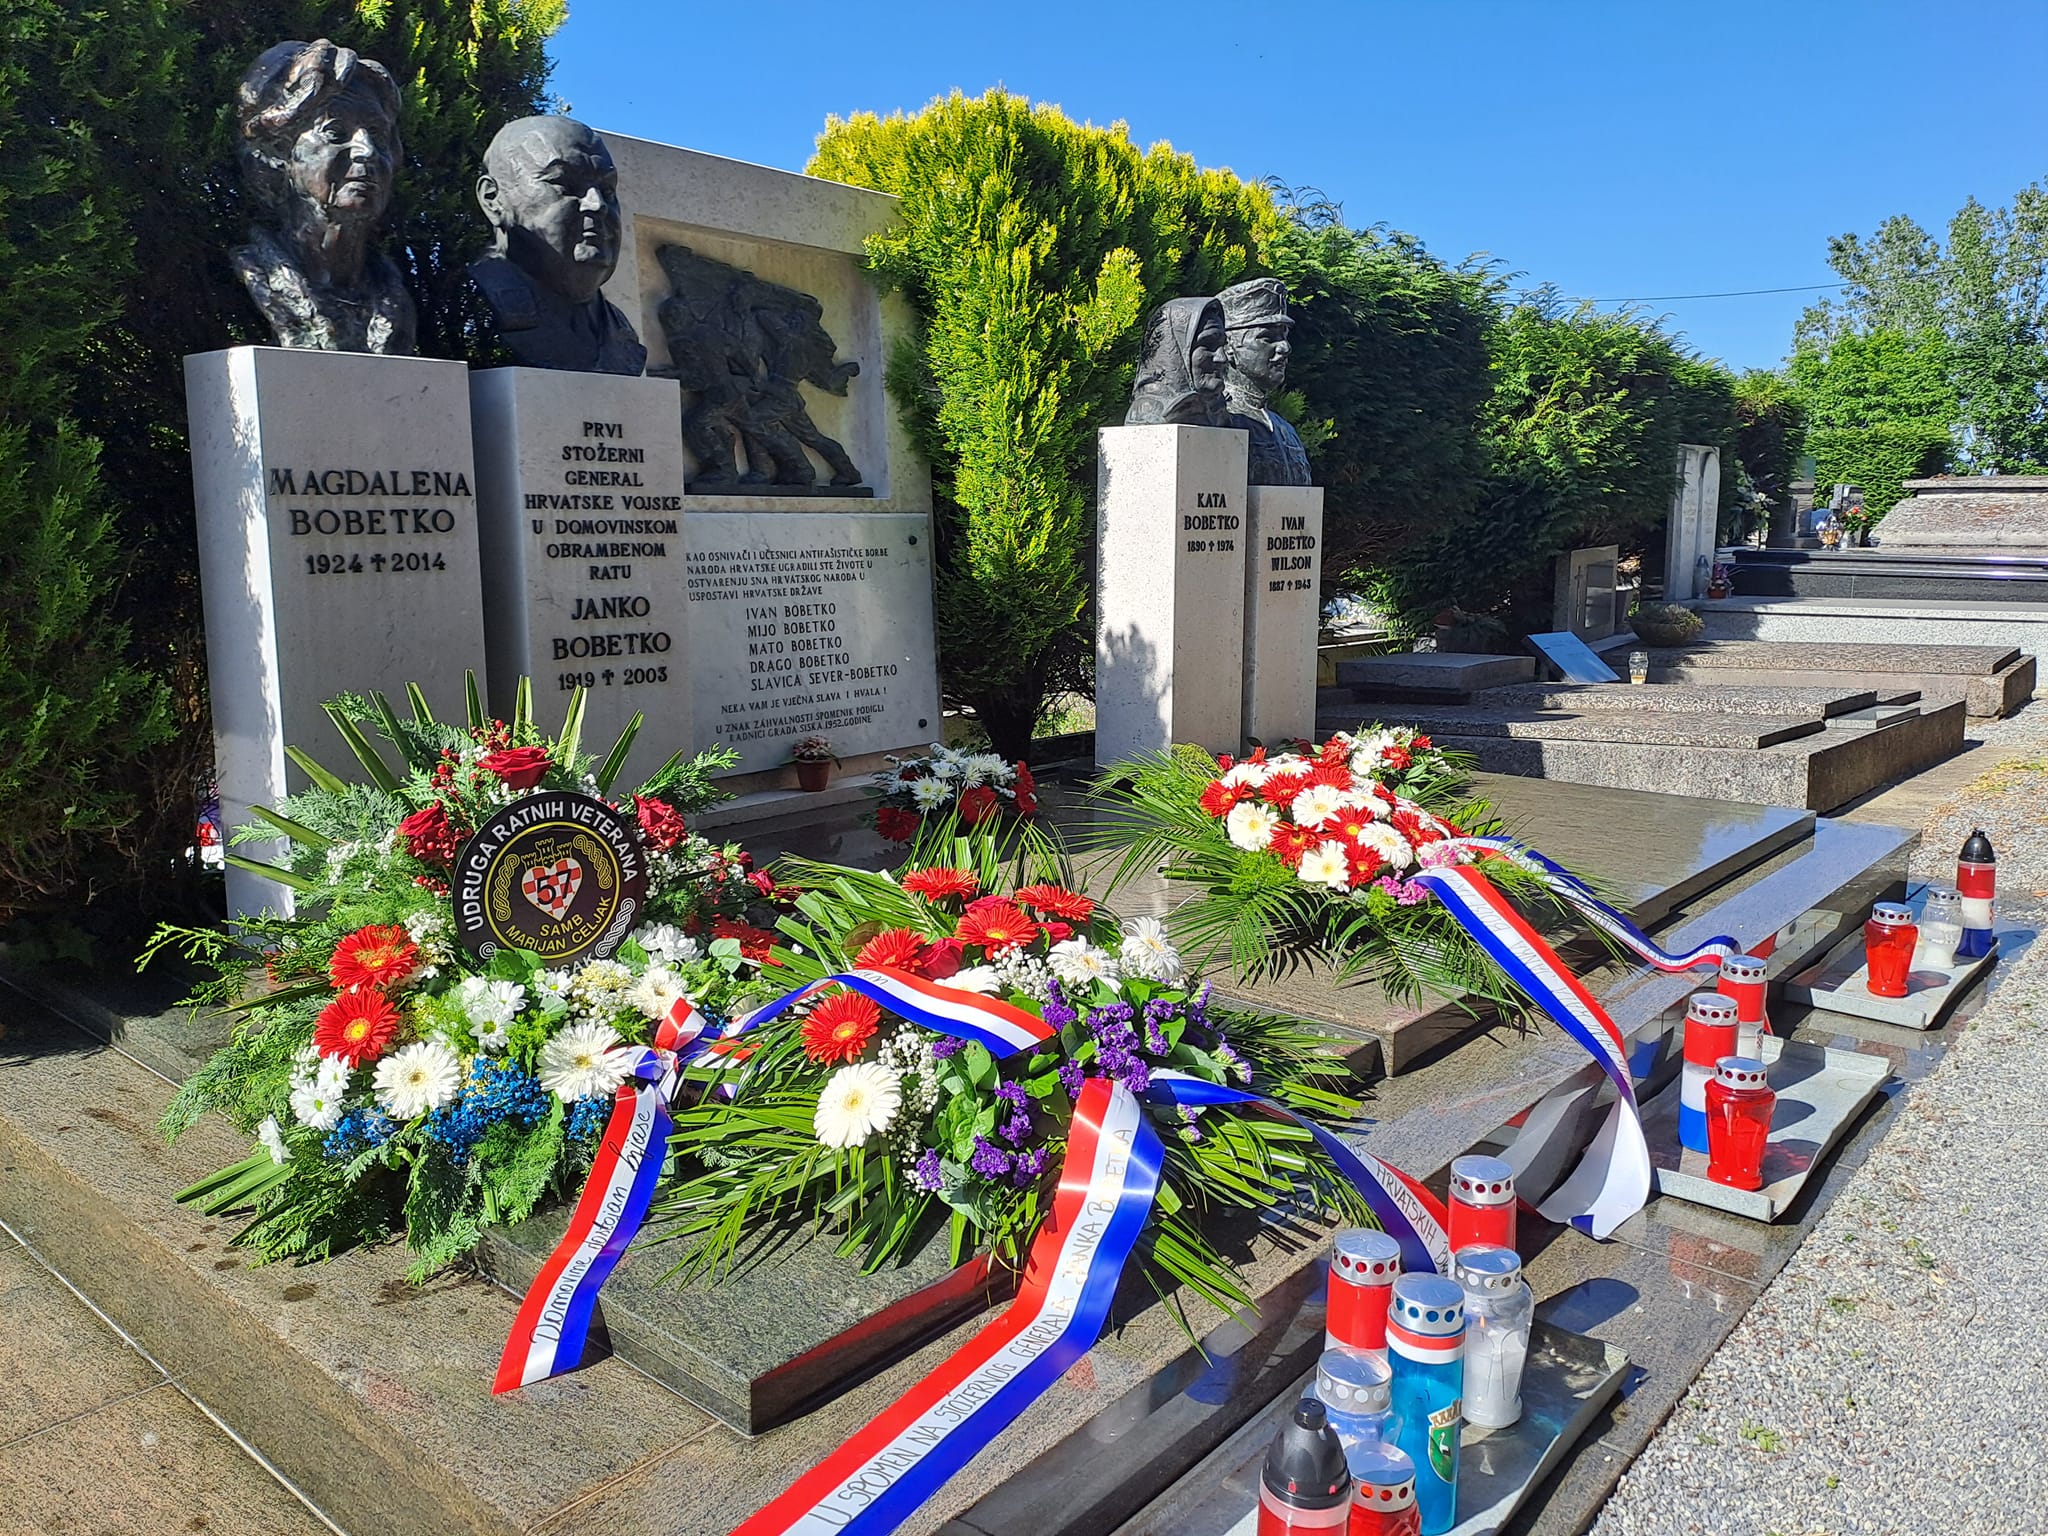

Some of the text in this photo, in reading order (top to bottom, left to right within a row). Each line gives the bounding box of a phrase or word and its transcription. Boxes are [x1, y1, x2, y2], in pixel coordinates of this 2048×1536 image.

[583, 421, 623, 438] PRVI
[562, 443, 644, 463] STOŽERNI
[270, 468, 472, 497] MAGDALENA
[565, 470, 644, 487] GENERAL
[524, 494, 682, 511] HRVATSKE VOJSKE
[1197, 493, 1227, 508] KATA
[289, 508, 455, 536] BOBETKO
[532, 519, 678, 535] U DOMOVINSKOM
[1184, 515, 1240, 531] BOBETKO
[1281, 517, 1305, 531] IVAN
[546, 542, 666, 559] OBRAMBENOM
[1267, 536, 1316, 551] BOBETKO
[305, 552, 446, 574] 1924 2014
[686, 552, 706, 562] KAO
[708, 550, 751, 561] OSNIVAČI
[865, 548, 889, 557] BORBE
[1271, 556, 1312, 571] WILSON
[589, 565, 631, 580] RATU
[687, 560, 873, 575] NARODA HRVATSKE UGRADILI STE ŽIVOTE U
[687, 572, 865, 588] OSTVARENJU SNA HRVATSKOG NARODA U
[688, 585, 823, 602] USPOSTAVI HRVATSKE DRŽAVE
[571, 596, 651, 620] JANKO
[746, 602, 836, 620] IVAN BOBETKO
[747, 619, 835, 638] MIJO BOBETKO
[552, 632, 671, 660] BOBETKO
[749, 636, 842, 657] MATO BOBETKO
[750, 652, 850, 674] DRAGO BOBETKO
[558, 666, 668, 691] 1919 2003
[751, 664, 898, 691] SLAVICA SEVER-BOBETKO
[721, 703, 746, 714] NEKA
[748, 701, 768, 711] VAM
[770, 699, 780, 709] JE
[782, 695, 814, 707] VJEČNA
[816, 692, 841, 703] SLAVA
[854, 687, 881, 698] HVALA
[715, 725, 722, 734] U
[724, 721, 751, 733] ZNAK
[815, 707, 854, 721] SPOMENIK
[767, 726, 798, 738] GRADA
[463, 801, 638, 931] UDRUGA RATNIH VETERANA
[536, 869, 573, 905] 57
[505, 896, 611, 952] MARIJAN CELJAK
[539, 914, 584, 937] SAMB
[1376, 1163, 1437, 1246] HRVATSKIH
[808, 1504, 852, 1526] U
[838, 1447, 921, 1507] SPOMEN
[906, 1424, 948, 1446] NA
